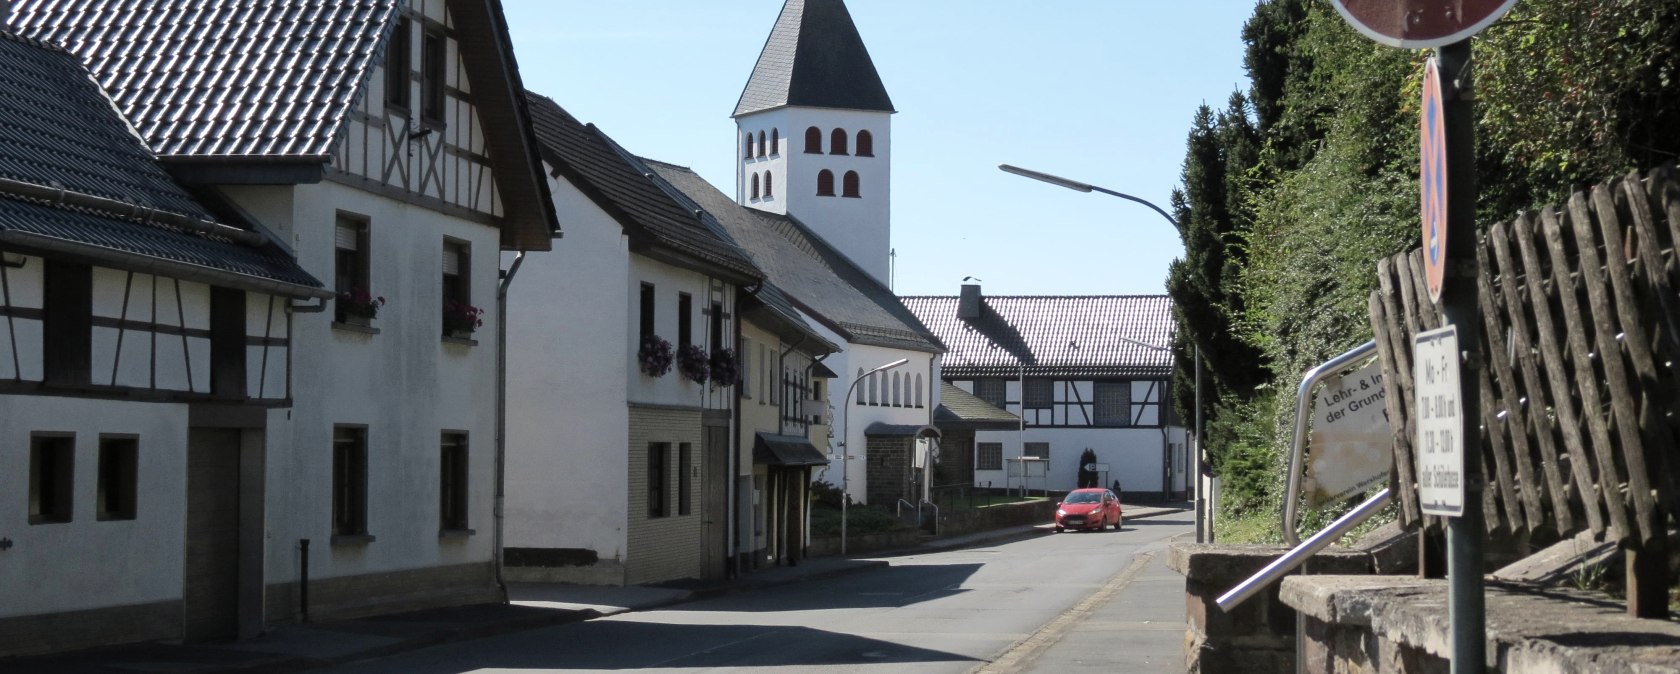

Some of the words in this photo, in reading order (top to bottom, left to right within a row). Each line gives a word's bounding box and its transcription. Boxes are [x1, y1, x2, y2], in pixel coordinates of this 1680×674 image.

[1425, 358, 1435, 385] Mo
[1441, 355, 1448, 383] Fr
[1324, 388, 1357, 407] Lehr-
[1359, 379, 1370, 391] &
[1326, 408, 1346, 424] der
